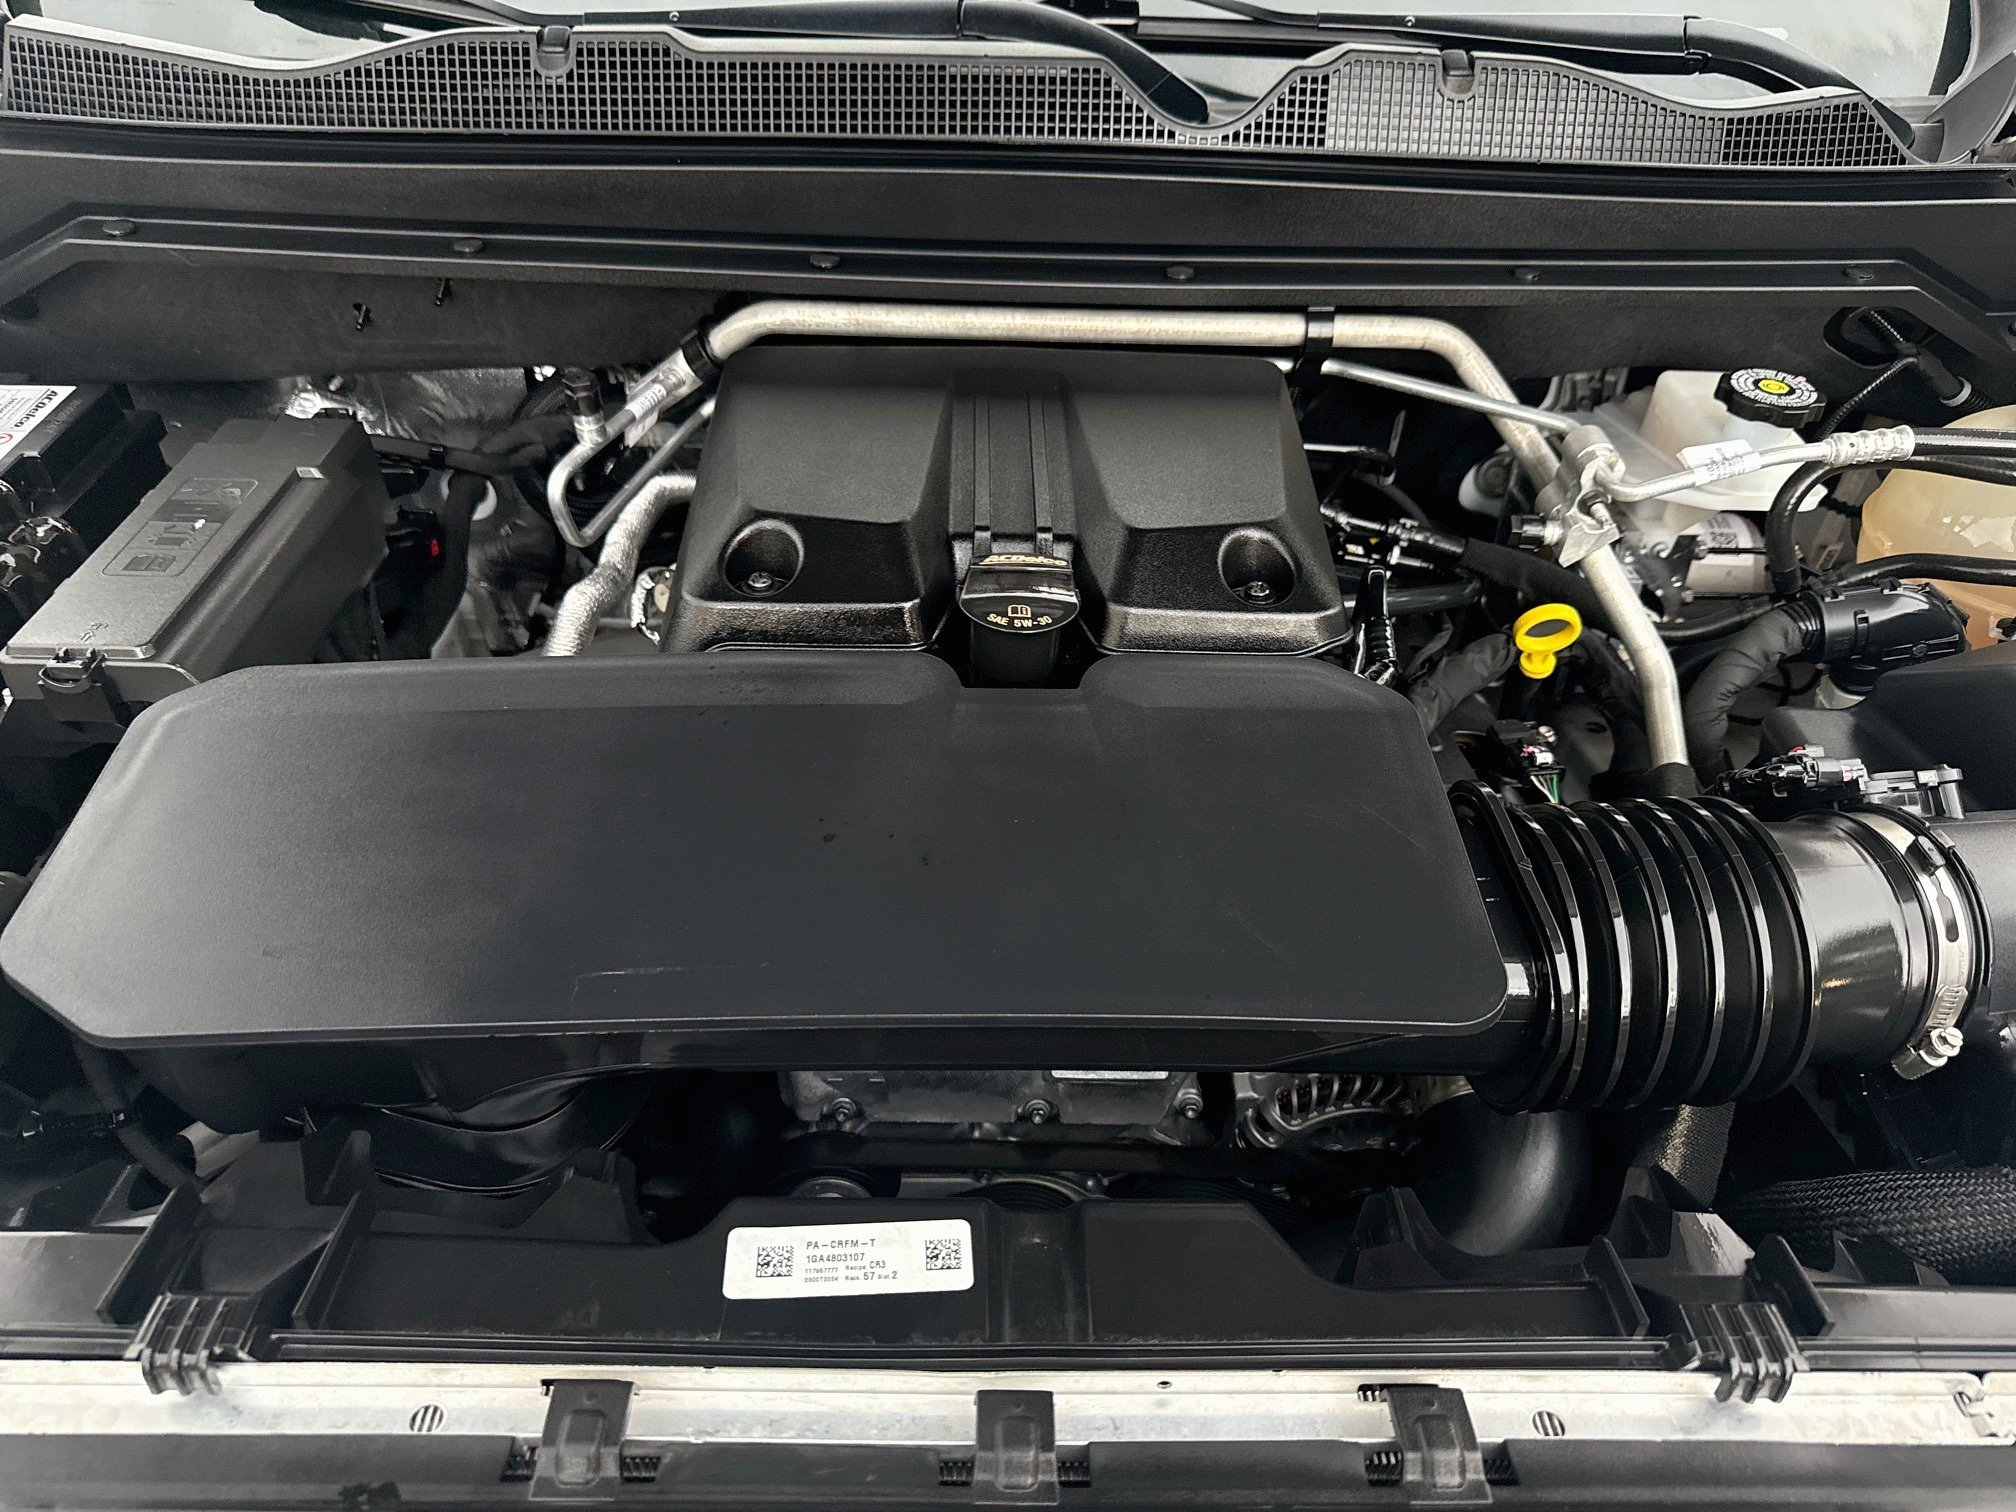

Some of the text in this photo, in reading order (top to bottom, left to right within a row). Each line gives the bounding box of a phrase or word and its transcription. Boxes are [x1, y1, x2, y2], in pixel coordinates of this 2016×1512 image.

[14, 389, 58, 428] ACDelco
[980, 555, 1067, 566] ACDelco
[987, 613, 1053, 628] SAE 5W-30
[806, 1252, 865, 1264] 1GA4803107
[869, 1260, 886, 1269] CR3
[863, 1272, 875, 1281] 57
[892, 1270, 898, 1279] 2
